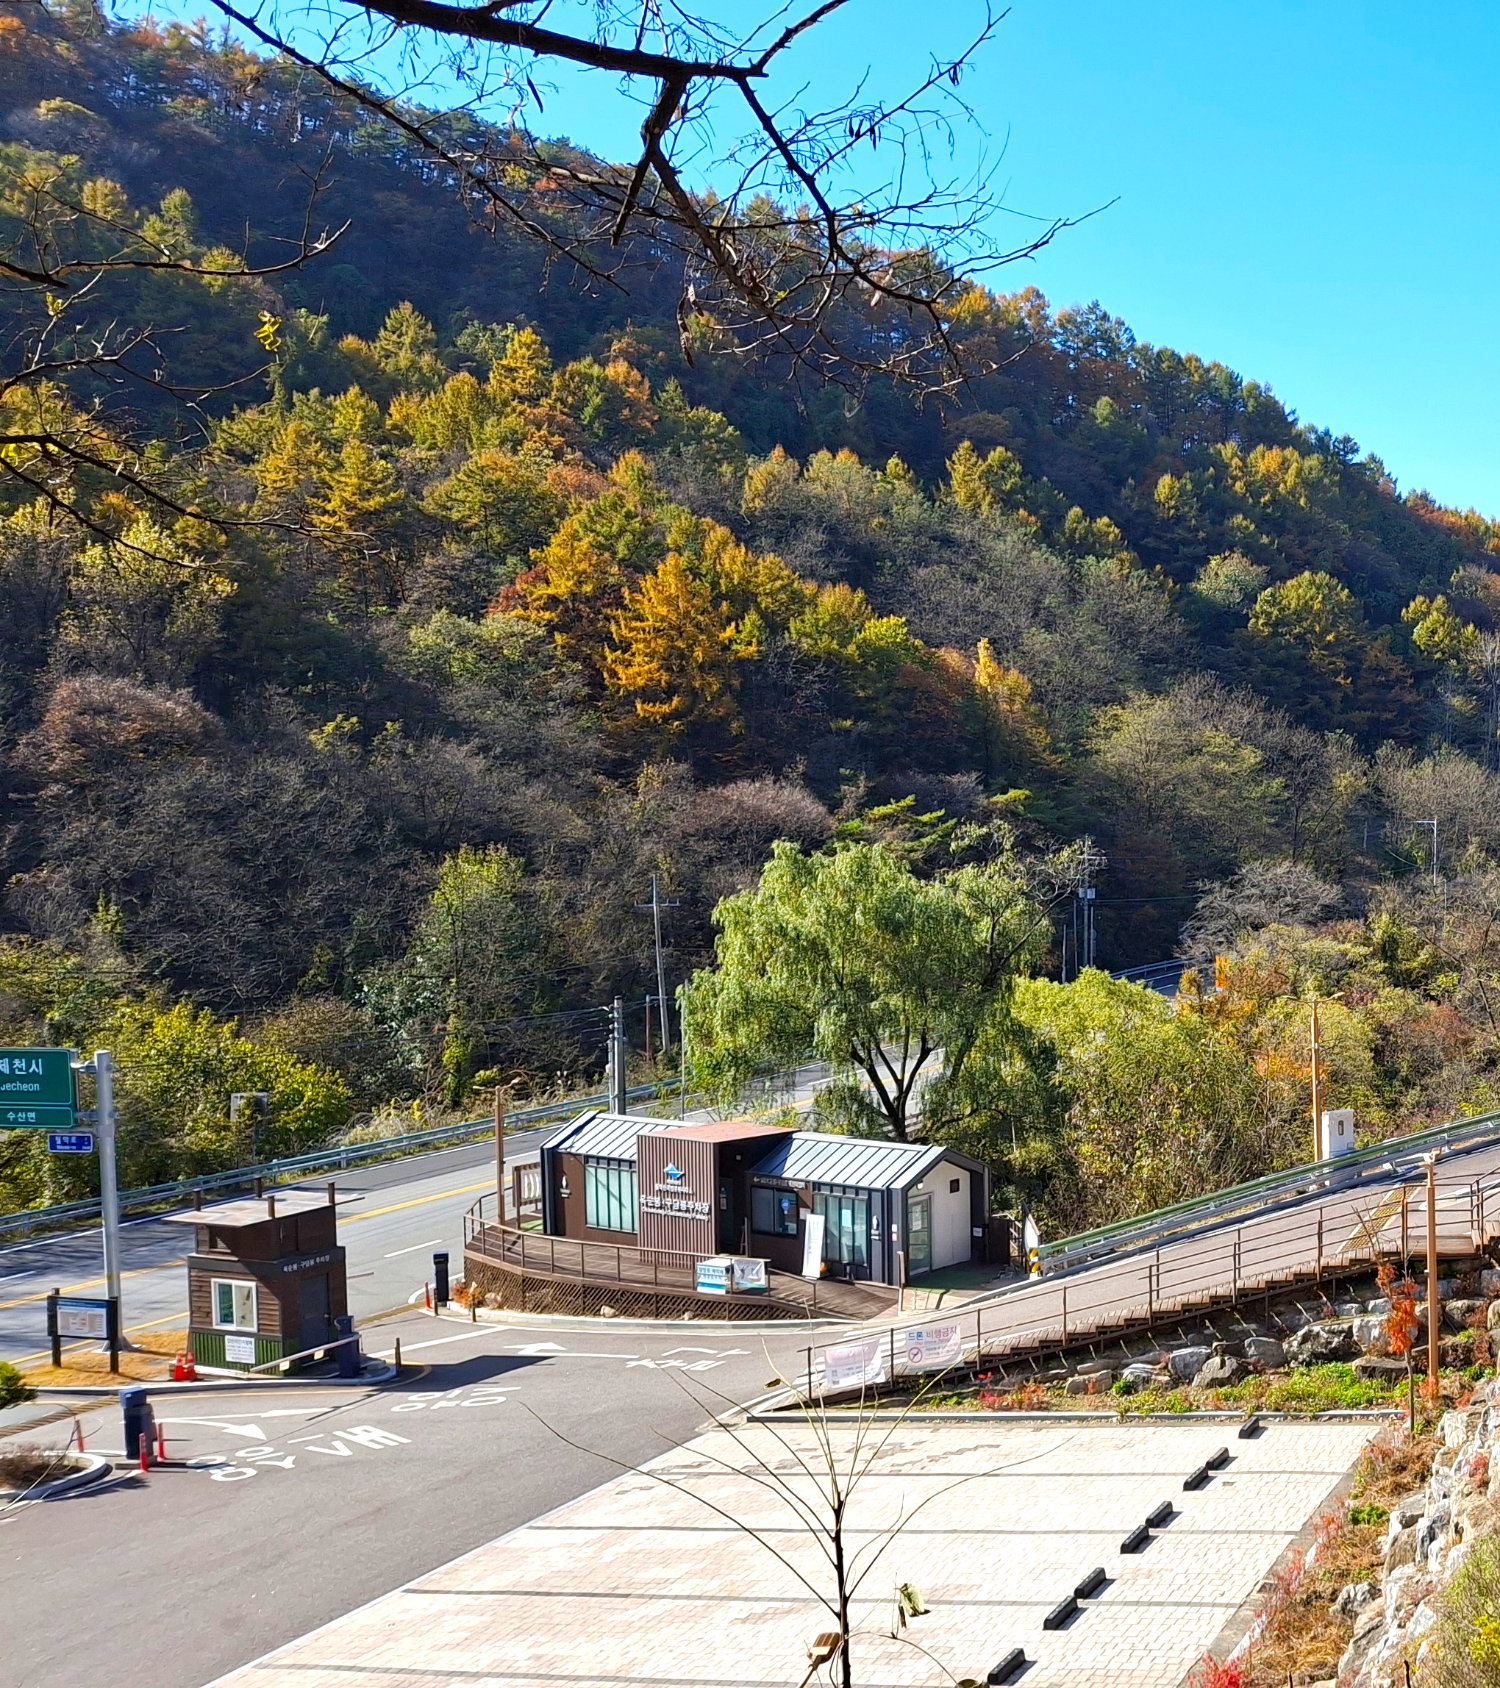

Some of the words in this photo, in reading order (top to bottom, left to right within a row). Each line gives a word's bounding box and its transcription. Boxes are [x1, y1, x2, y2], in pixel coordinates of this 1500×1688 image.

[0, 1057, 43, 1076] 제천시
[0, 1080, 40, 1091] Jecheon
[7, 1111, 37, 1122] 수산면
[908, 1331, 924, 1341] 드론
[926, 1325, 957, 1340] 비행금지
